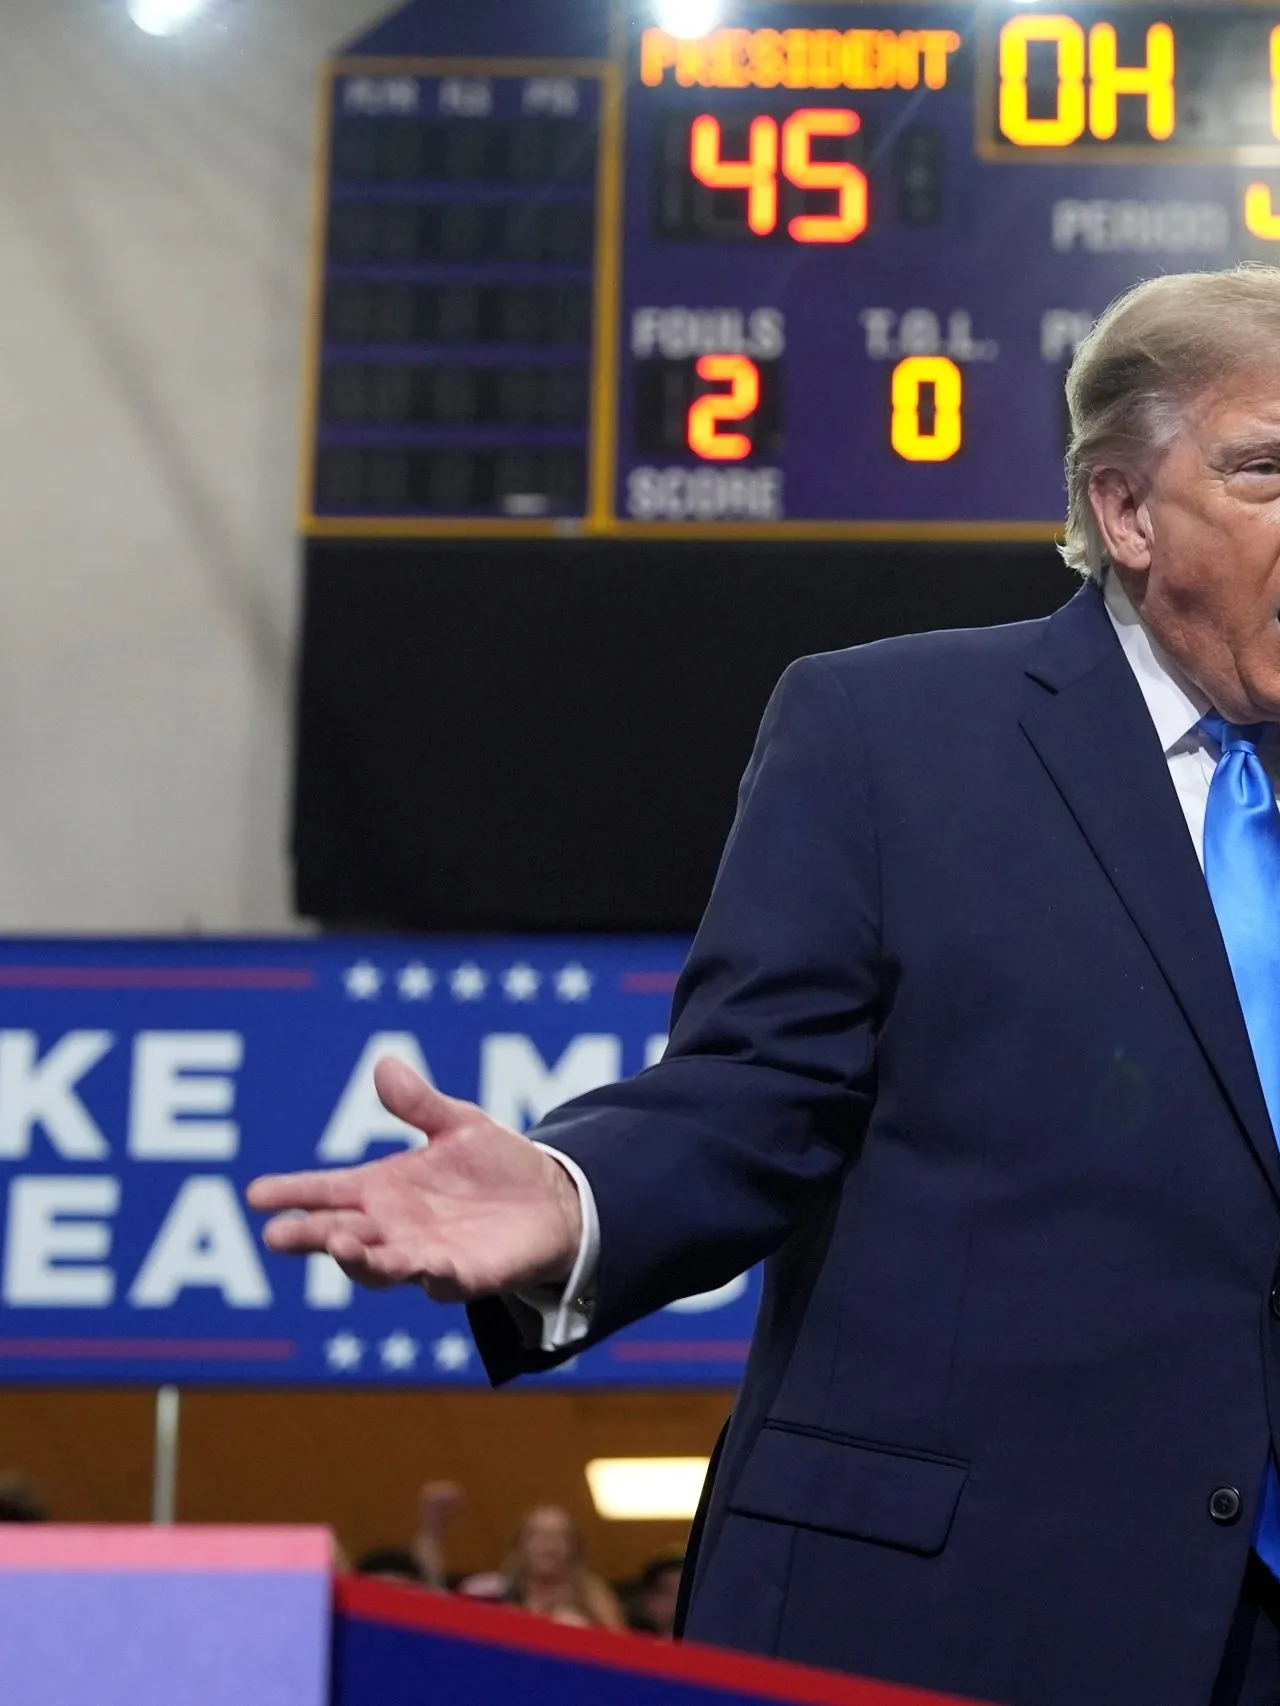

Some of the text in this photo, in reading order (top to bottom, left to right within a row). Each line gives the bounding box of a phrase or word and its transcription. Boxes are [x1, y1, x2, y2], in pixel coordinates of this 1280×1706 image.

[640, 28, 960, 89] PRESIDENT
[690, 108, 868, 243] 45
[1053, 200, 1228, 252] PERIOD
[632, 307, 785, 360] FOULS
[687, 354, 759, 460] 2
[891, 356, 961, 461] 0
[628, 467, 784, 520] SCORE
